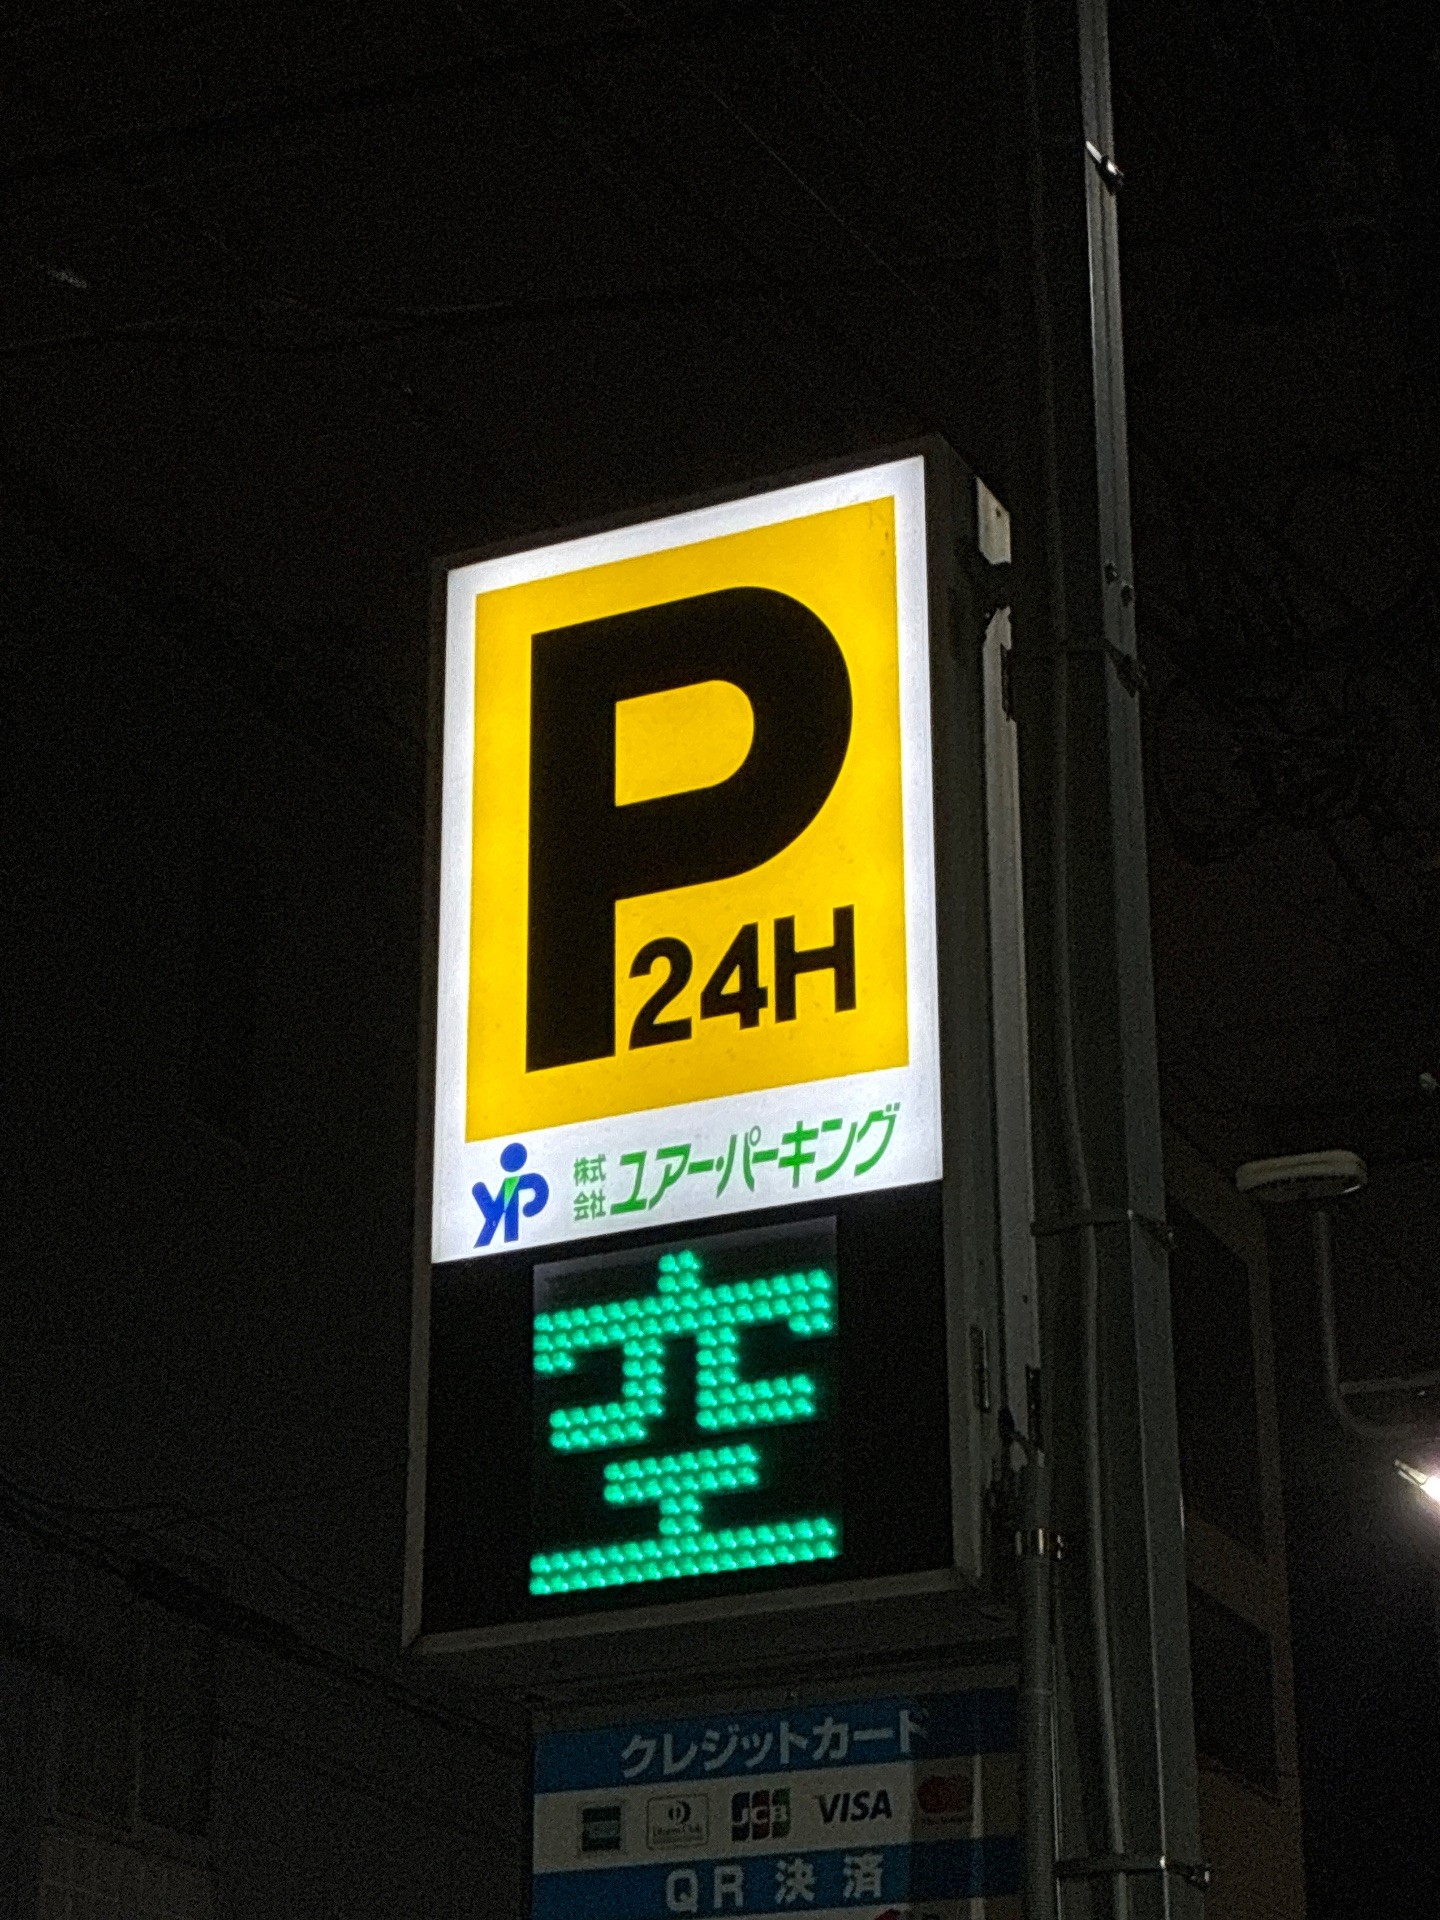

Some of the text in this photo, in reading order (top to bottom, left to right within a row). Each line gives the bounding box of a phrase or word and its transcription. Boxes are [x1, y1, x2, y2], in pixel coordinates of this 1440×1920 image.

[526, 585, 853, 1073] P
[628, 903, 858, 1050] 24H
[573, 1153, 607, 1187] 株式
[573, 1188, 607, 1222] 会社
[529, 1249, 838, 1595] 空
[621, 1708, 928, 1778] クレジットカード
[818, 1790, 892, 1824] VISA
